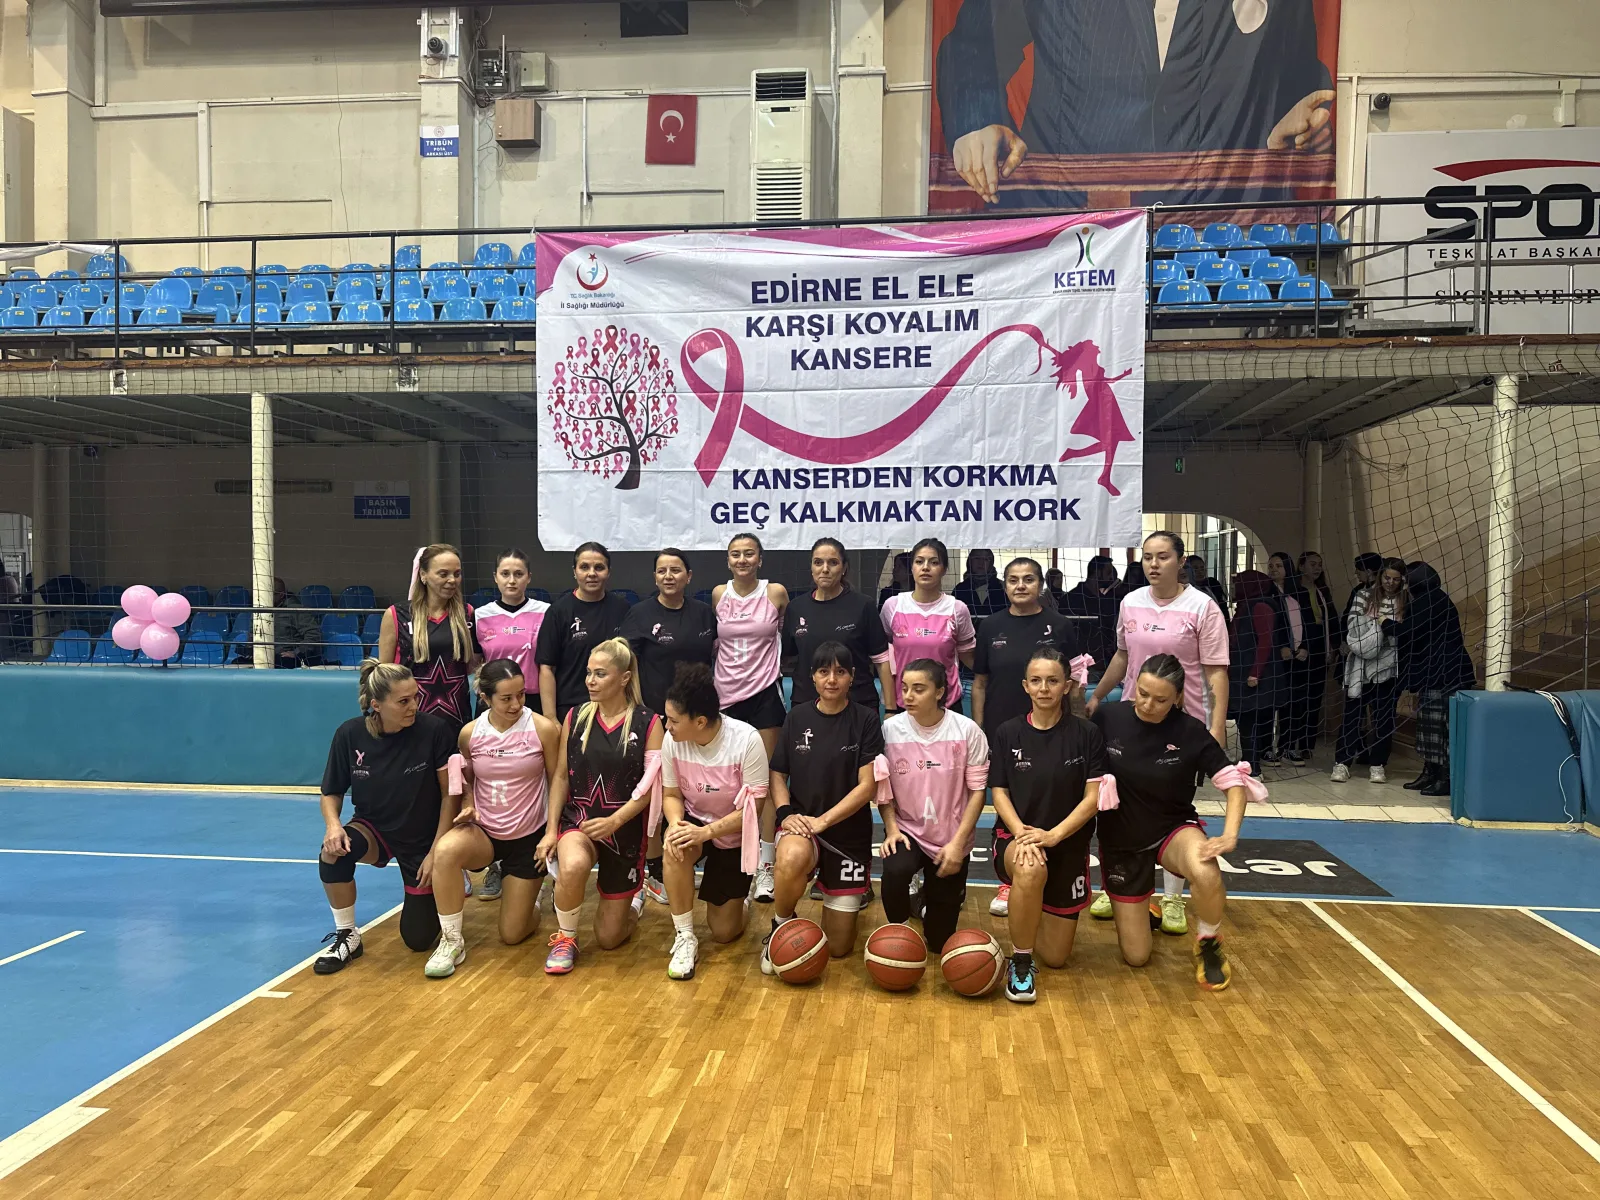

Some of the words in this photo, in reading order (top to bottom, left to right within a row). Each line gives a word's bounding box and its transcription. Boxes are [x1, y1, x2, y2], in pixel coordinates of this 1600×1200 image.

[1424, 183, 1600, 241] SPO
[1427, 247, 1518, 260] TEŞKAT
[1529, 246, 1600, 259] BAŞKA
[751, 272, 862, 304] EDİRNE
[872, 276, 909, 300] EL
[918, 273, 974, 299] ELE
[1054, 269, 1115, 288] KETEM
[566, 302, 589, 310] Sağlığı
[590, 301, 625, 310] Müdürlüğü
[746, 313, 834, 342] KARŞI
[845, 308, 979, 335] KOYALIM
[790, 345, 932, 371] KANSERE
[732, 466, 912, 490] KANSERDEN
[923, 463, 1058, 488] KORKMA
[710, 501, 770, 530] GEÇ
[780, 499, 983, 524] KALKMAKTAN
[993, 498, 1081, 521] KORK
[491, 780, 509, 807] R
[923, 796, 939, 825] A
[628, 867, 637, 883] 4
[840, 859, 866, 882] 22
[1071, 875, 1086, 900] 19
